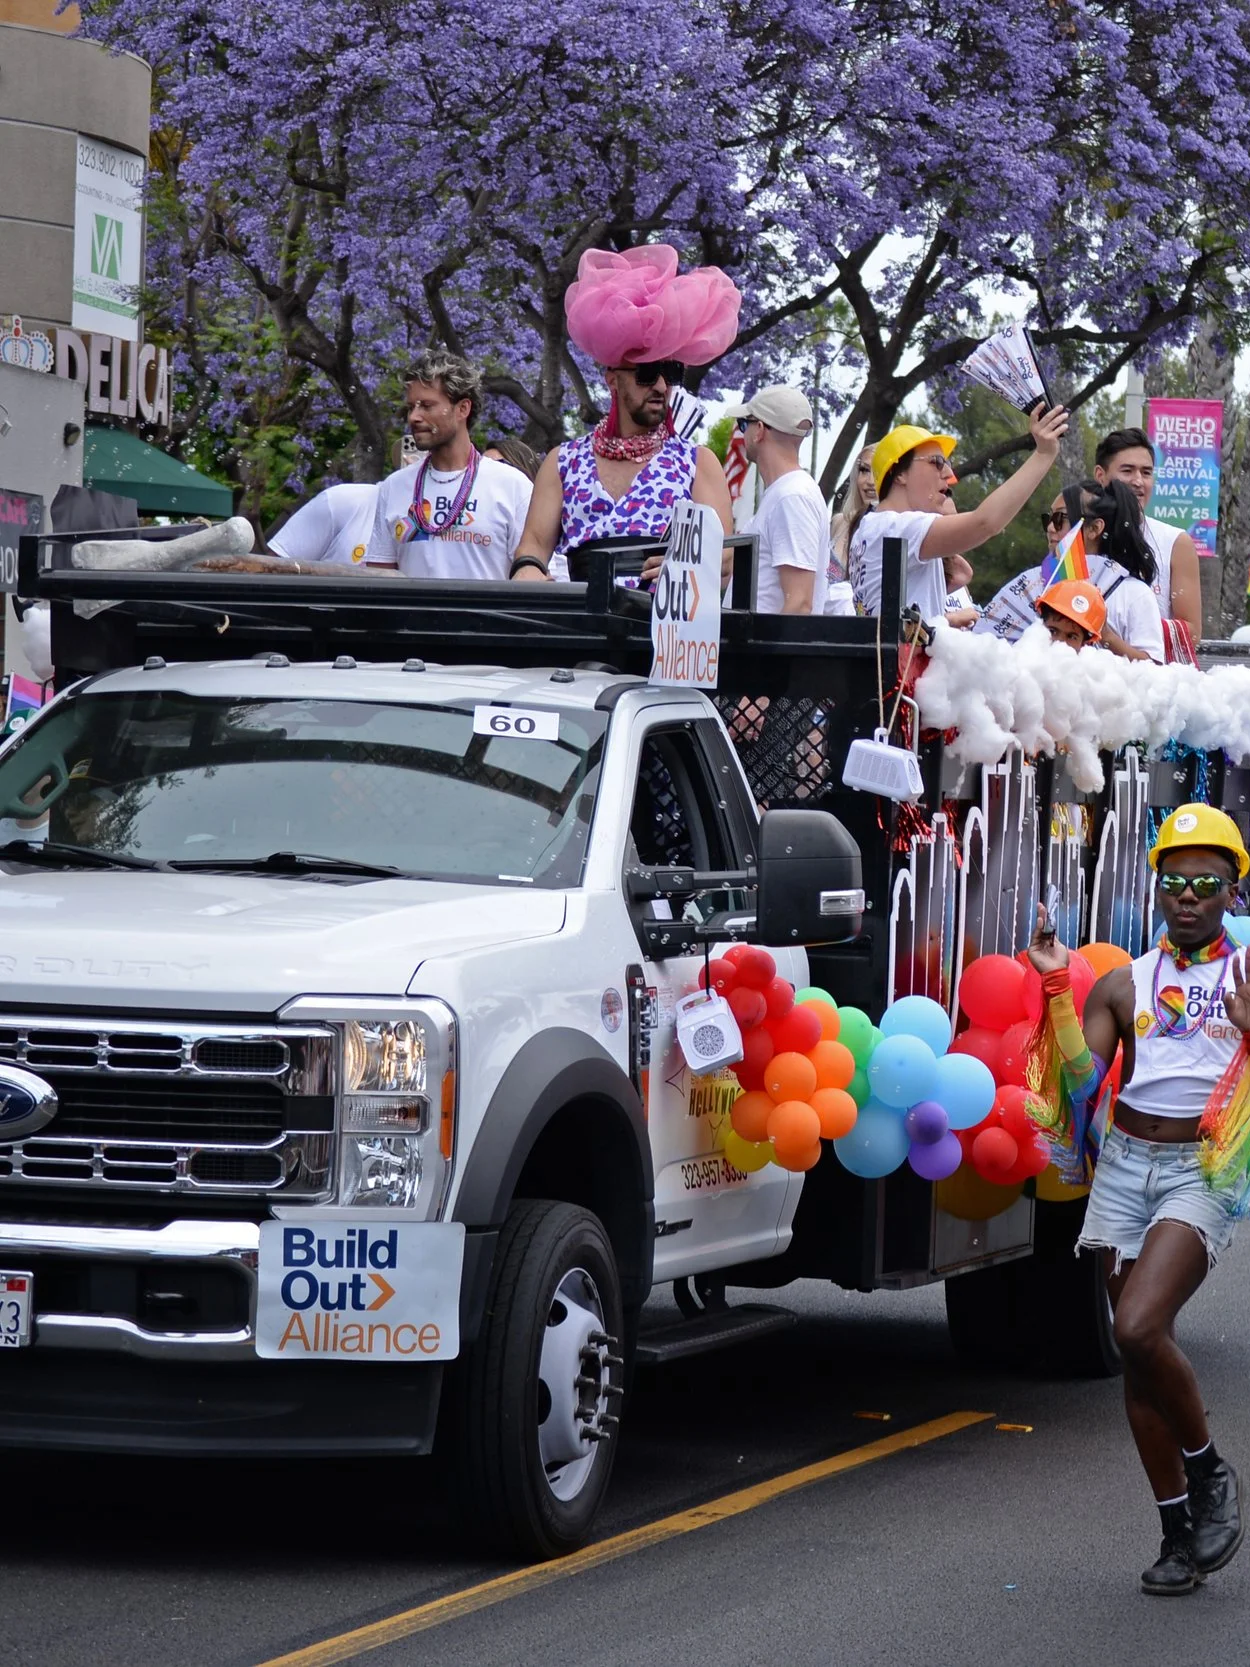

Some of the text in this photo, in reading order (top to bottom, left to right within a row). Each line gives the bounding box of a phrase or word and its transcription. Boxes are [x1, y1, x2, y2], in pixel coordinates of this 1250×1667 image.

[54, 327, 174, 431] DELICA
[1155, 417, 1216, 433] WEHO
[1155, 432, 1214, 449] PRIDE
[1164, 457, 1202, 468] ARTS
[1156, 484, 1211, 497] MAY 23
[1154, 506, 1210, 520] MAY 25
[655, 564, 688, 622] Out
[651, 624, 717, 682] Alliance
[489, 715, 536, 734] 60
[689, 1084, 741, 1119] HOLLYWO
[283, 1227, 398, 1269] Build
[280, 1270, 367, 1311] Out
[277, 1312, 441, 1354] Alliance
